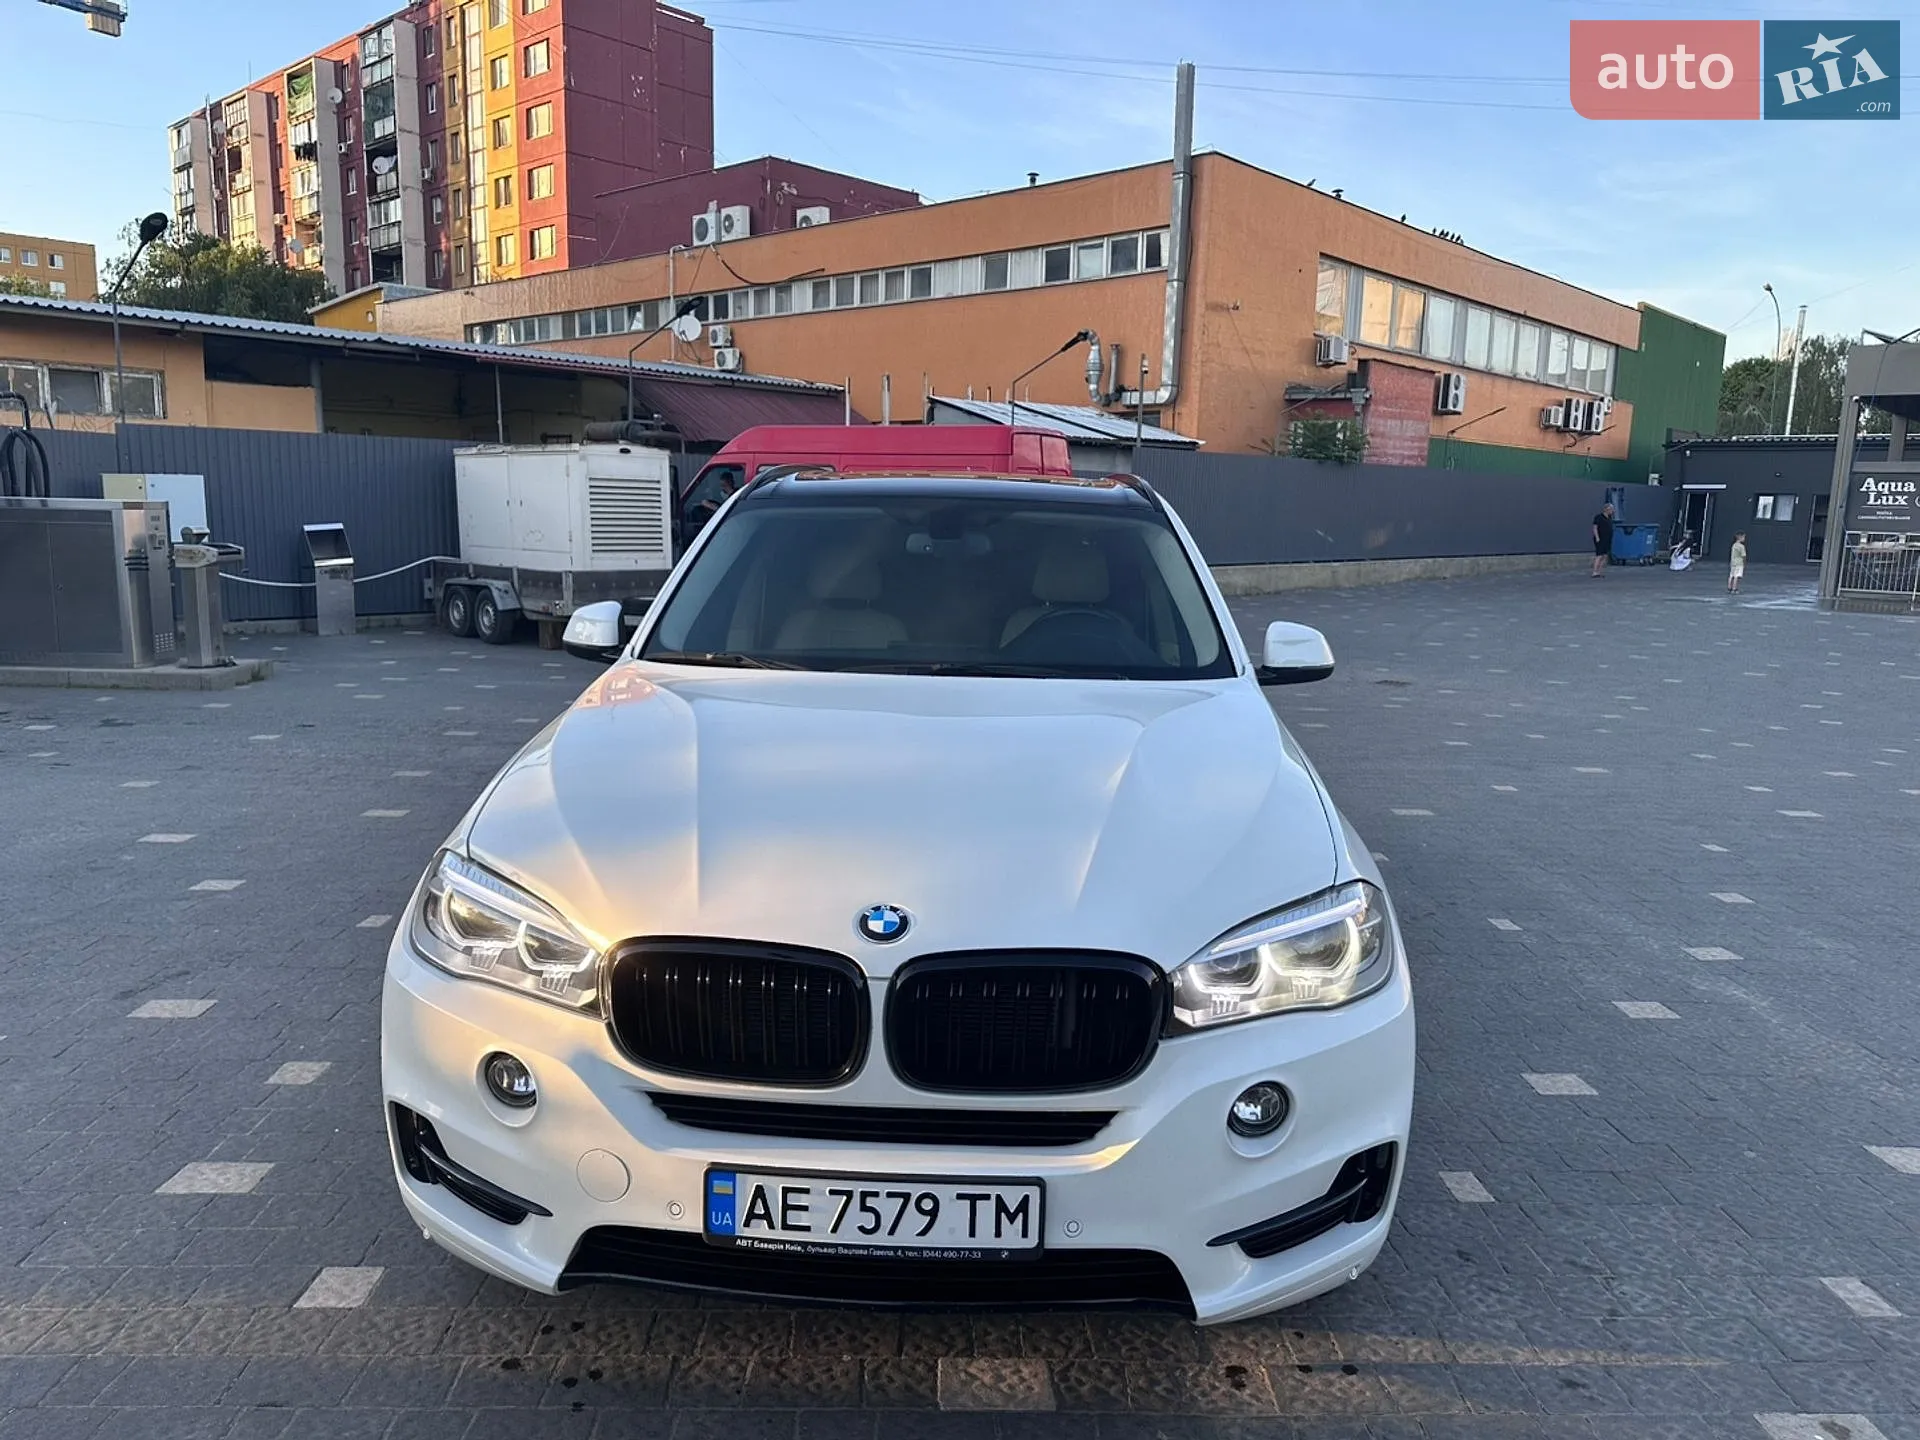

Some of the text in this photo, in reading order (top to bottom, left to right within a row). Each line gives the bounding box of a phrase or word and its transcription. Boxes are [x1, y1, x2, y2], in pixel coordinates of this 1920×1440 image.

[1860, 477, 1917, 494] Aqua
[1867, 492, 1909, 505] Lux
[712, 1211, 733, 1226] UA
[742, 1183, 1030, 1239] AE 7579 TM
